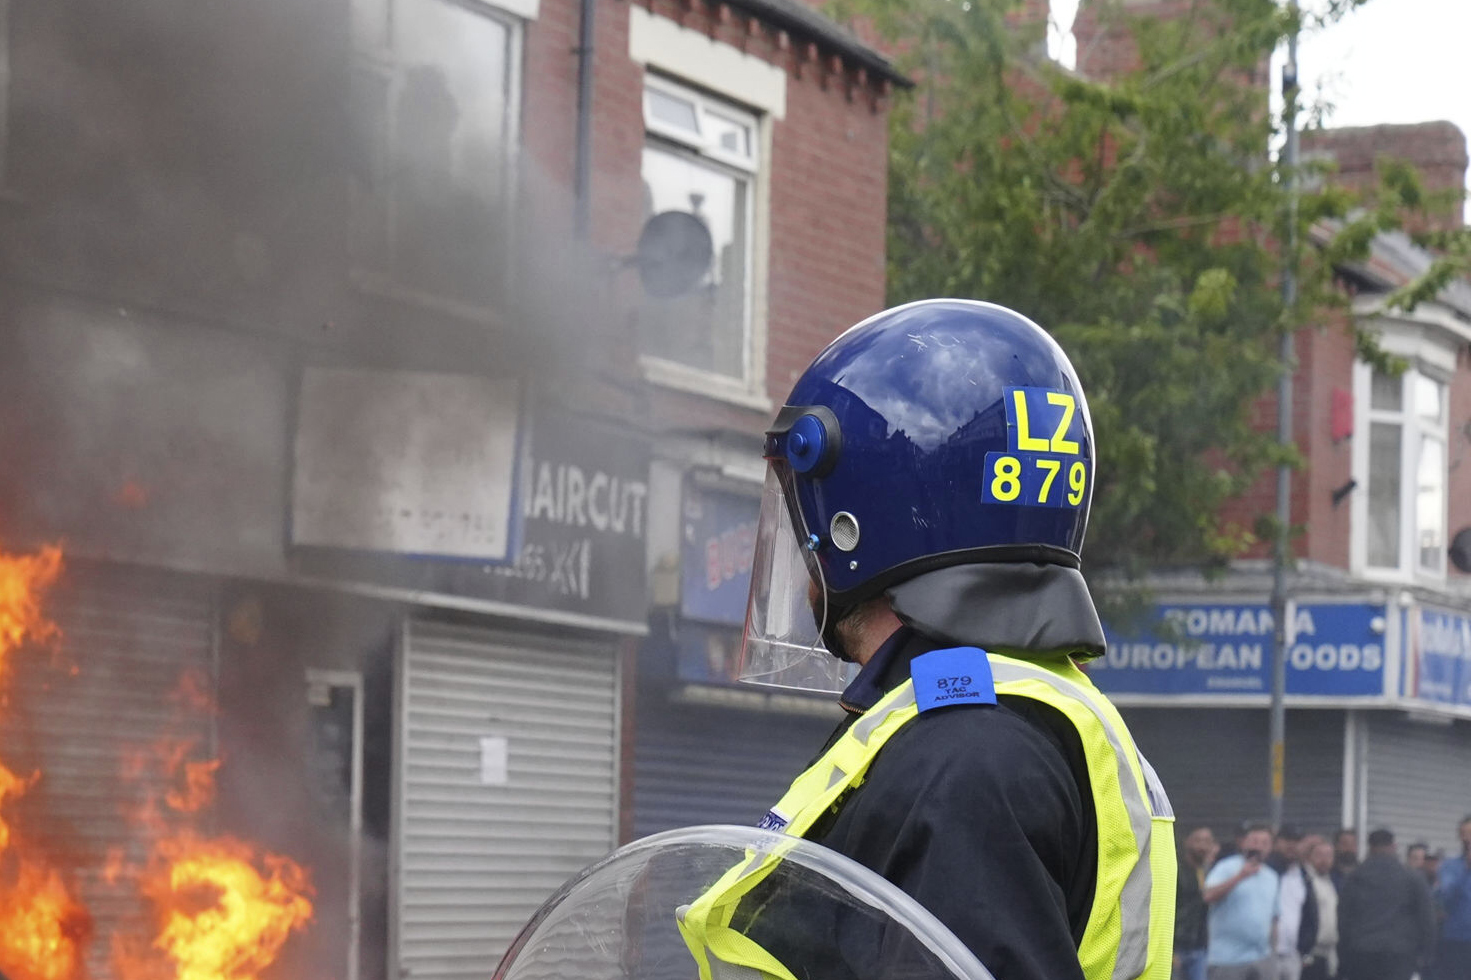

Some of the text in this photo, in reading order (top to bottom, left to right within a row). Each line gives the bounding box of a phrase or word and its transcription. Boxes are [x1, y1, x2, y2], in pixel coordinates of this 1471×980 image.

[1013, 390, 1079, 455] LZ
[991, 456, 1086, 506] 879
[1285, 643, 1381, 671] OODS
[935, 692, 980, 701] ADVISOR
[937, 676, 972, 689] 879
